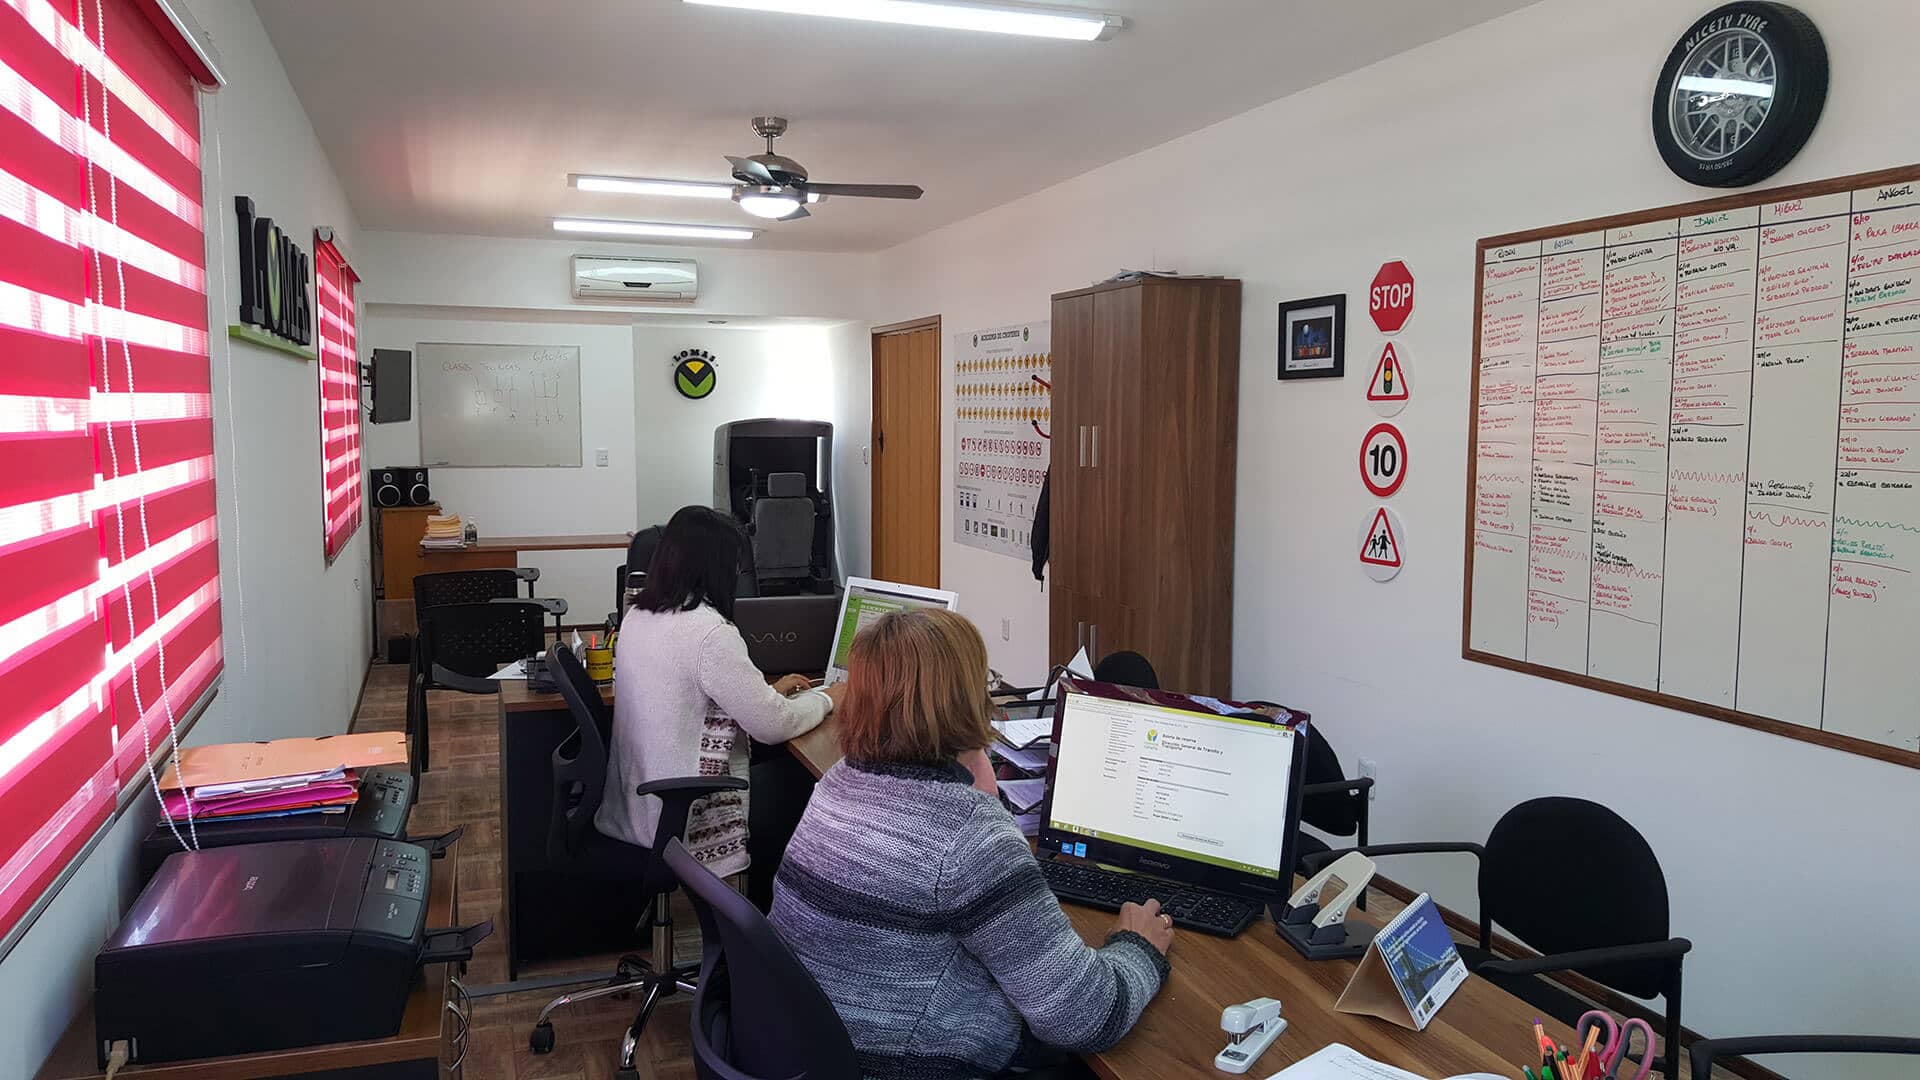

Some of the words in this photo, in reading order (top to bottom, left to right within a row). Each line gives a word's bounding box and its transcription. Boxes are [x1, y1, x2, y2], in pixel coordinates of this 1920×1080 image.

[1685, 14, 1733, 51] NICETY
[1737, 13, 1768, 33] TYRE
[1371, 283, 1411, 311] STOP
[673, 349, 716, 362] LOMAS
[1369, 444, 1397, 477] 10
[750, 632, 798, 642] VAIO
